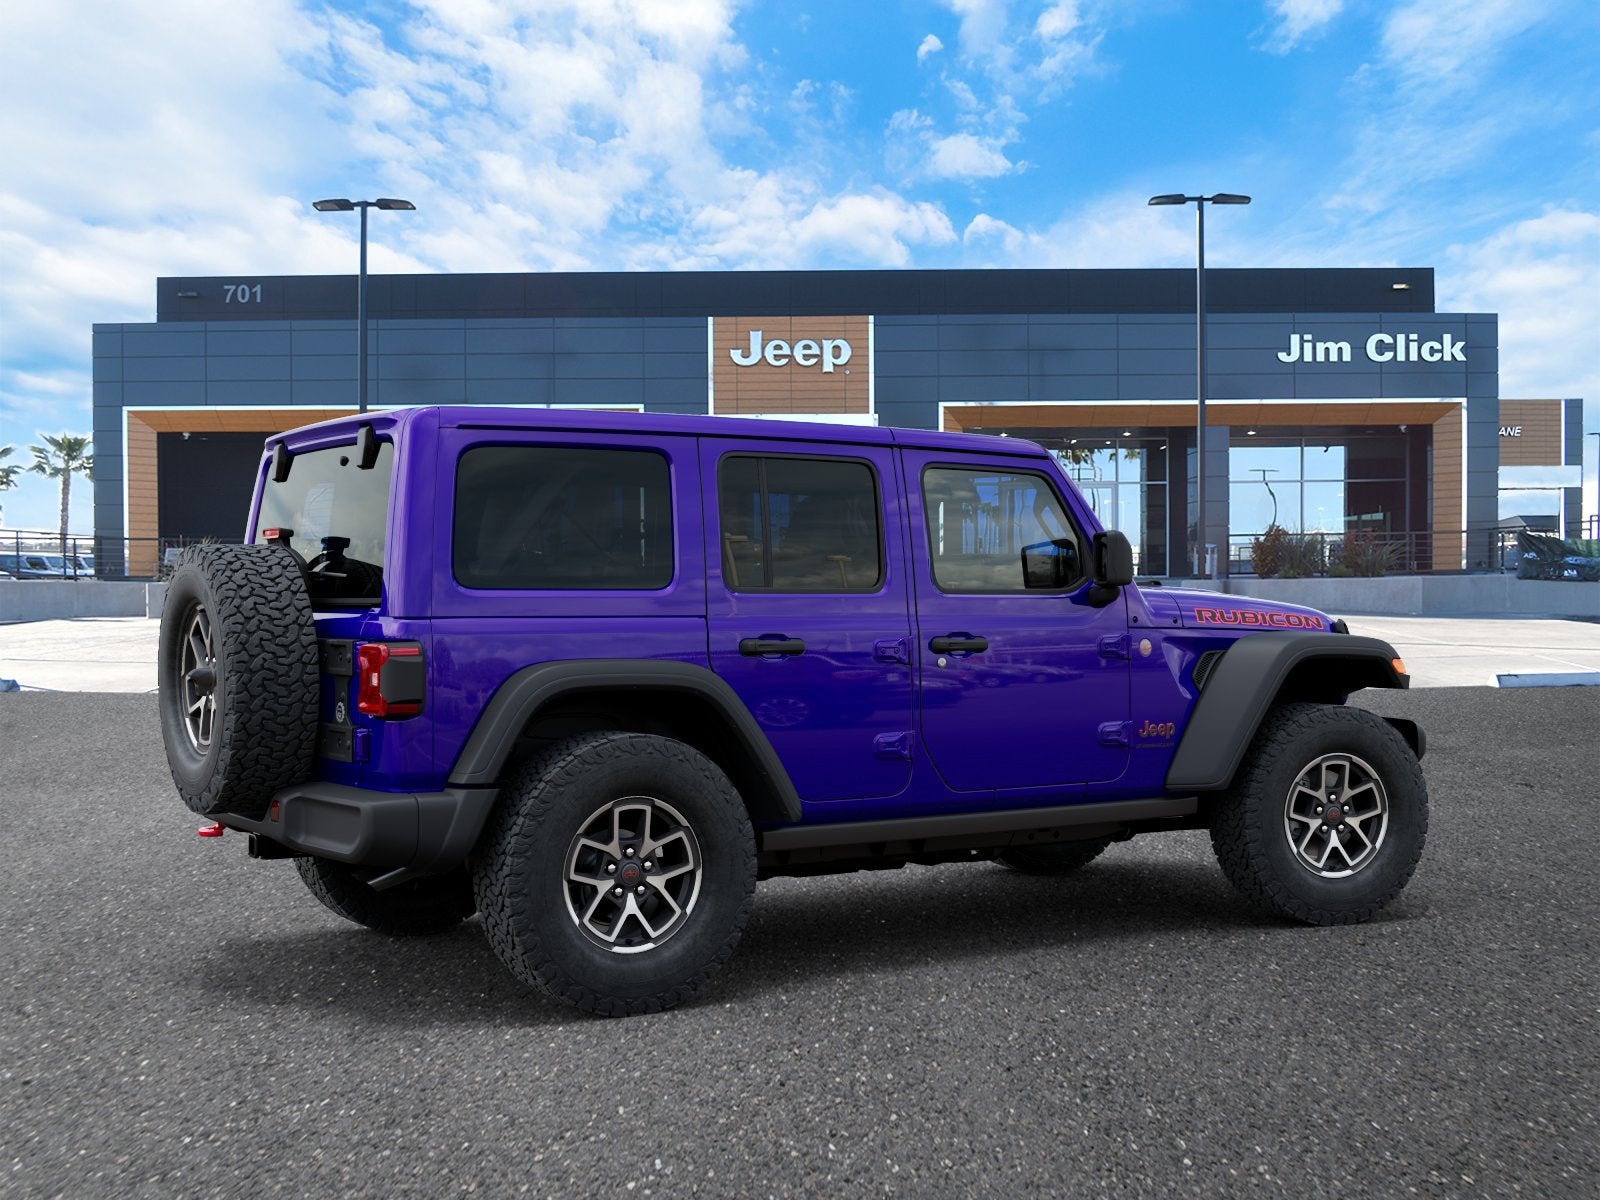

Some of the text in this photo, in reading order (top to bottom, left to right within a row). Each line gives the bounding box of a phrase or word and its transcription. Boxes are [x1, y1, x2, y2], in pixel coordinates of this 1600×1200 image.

[223, 284, 262, 304] 701
[729, 329, 852, 374] Jeep
[1277, 333, 1467, 363] Jim Click
[1194, 607, 1324, 630] RUBICON
[1137, 719, 1176, 740] Jeep
